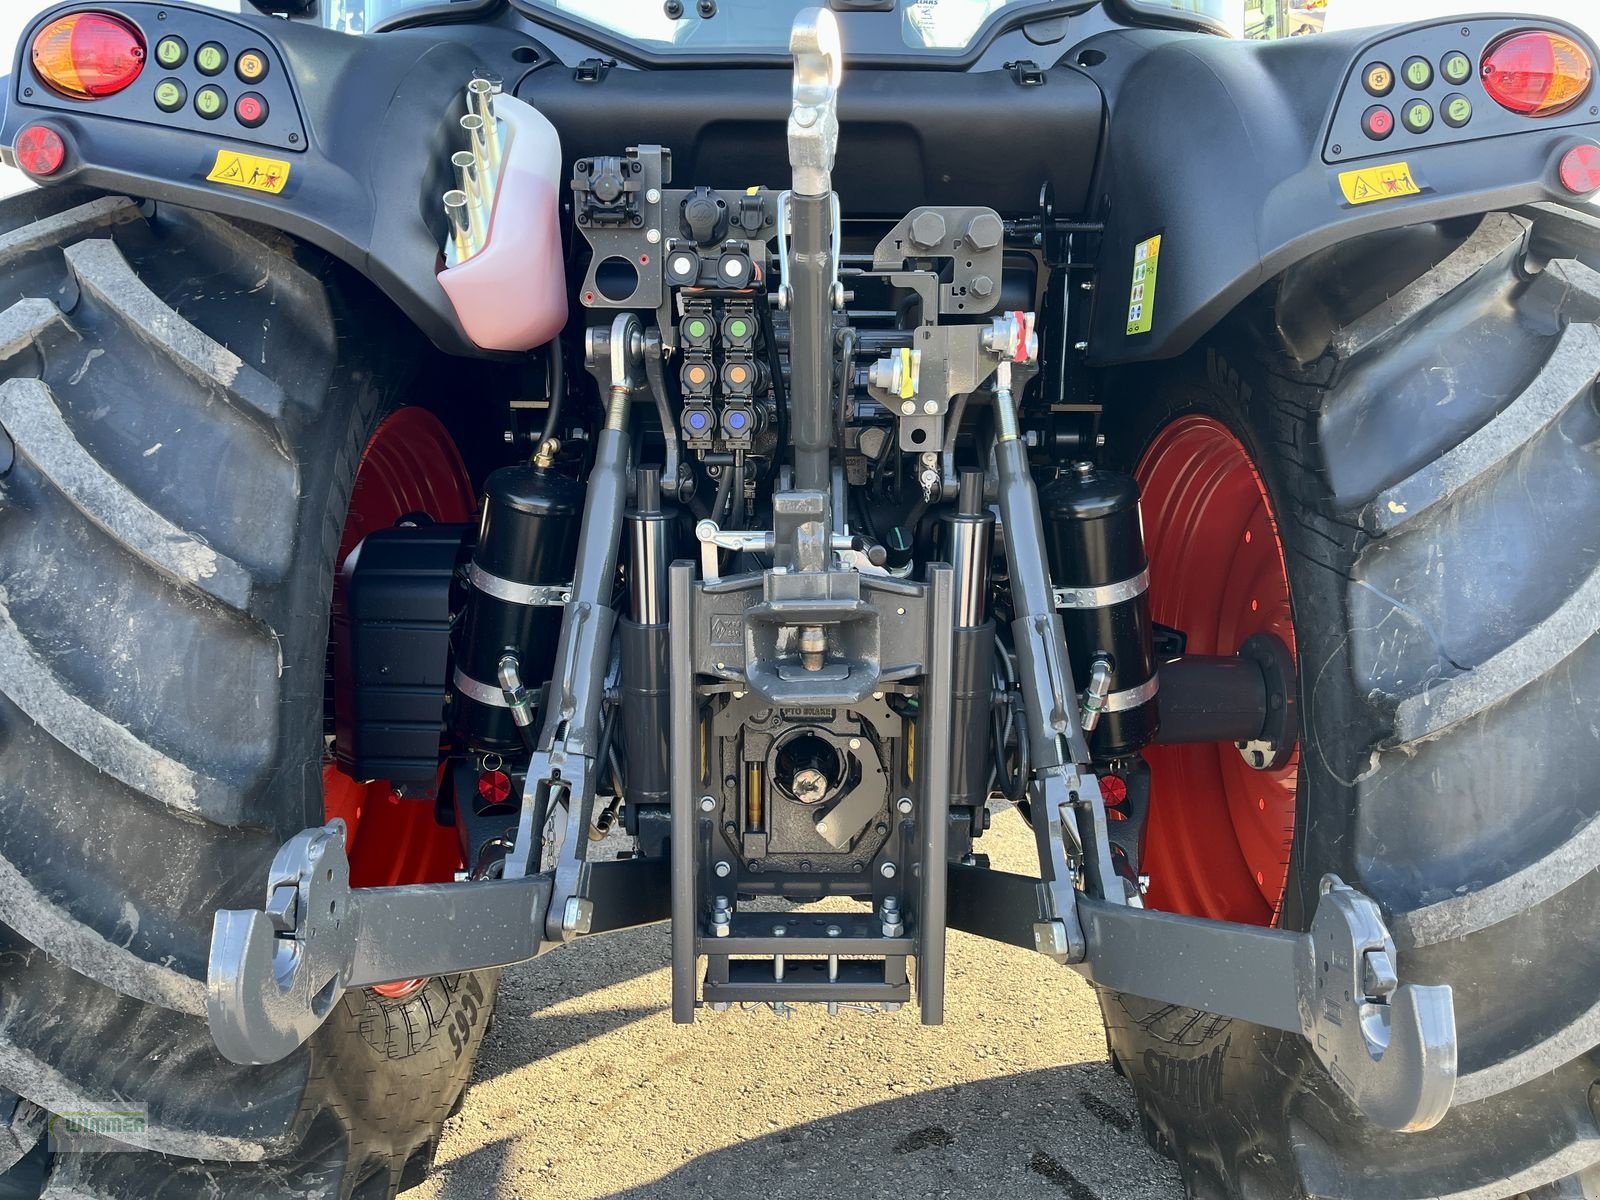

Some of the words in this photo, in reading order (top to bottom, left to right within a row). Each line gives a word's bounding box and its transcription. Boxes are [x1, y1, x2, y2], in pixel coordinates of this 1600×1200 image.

[894, 240, 903, 250] T
[953, 240, 962, 250] P
[951, 286, 967, 296] LS
[785, 707, 801, 715] PTO
[803, 707, 831, 715] BRAKE
